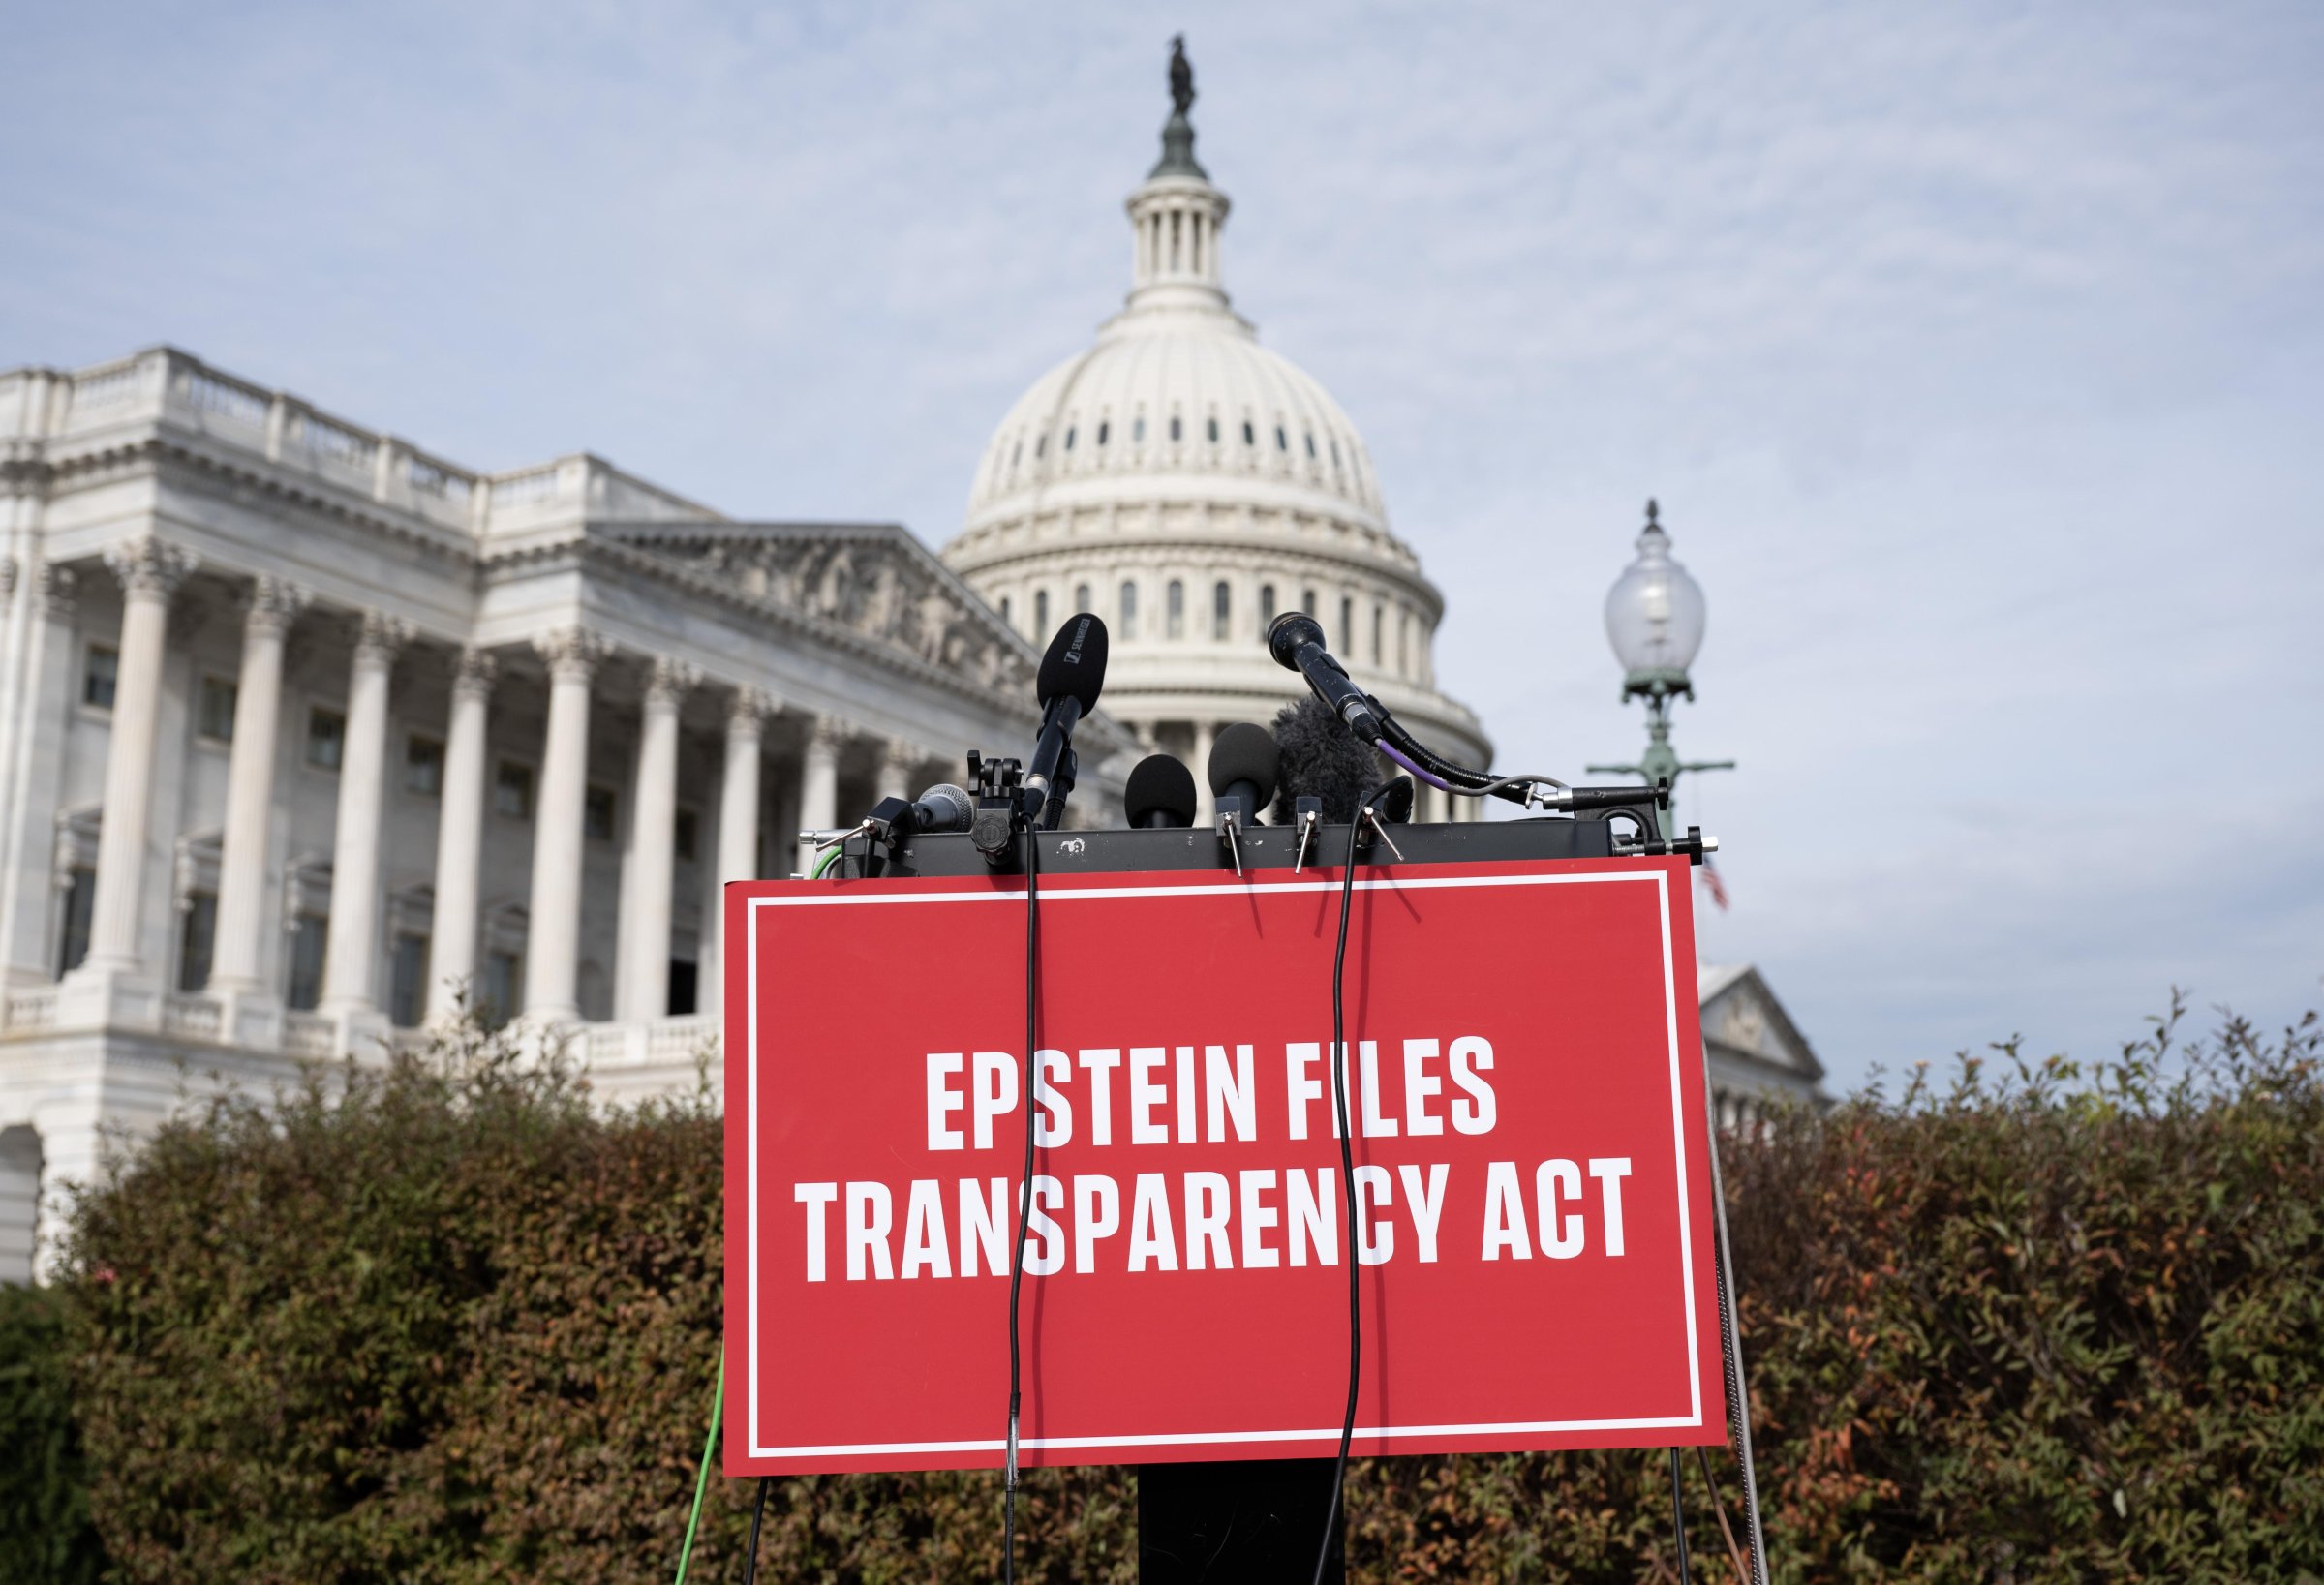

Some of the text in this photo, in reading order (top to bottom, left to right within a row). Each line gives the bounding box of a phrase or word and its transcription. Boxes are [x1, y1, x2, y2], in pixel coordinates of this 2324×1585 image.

[1071, 618, 1091, 651] SENNHEISER
[926, 1035, 1497, 1151] EPSTEIN FILES
[794, 1157, 1633, 1283] TRANSPARENCY ACT
